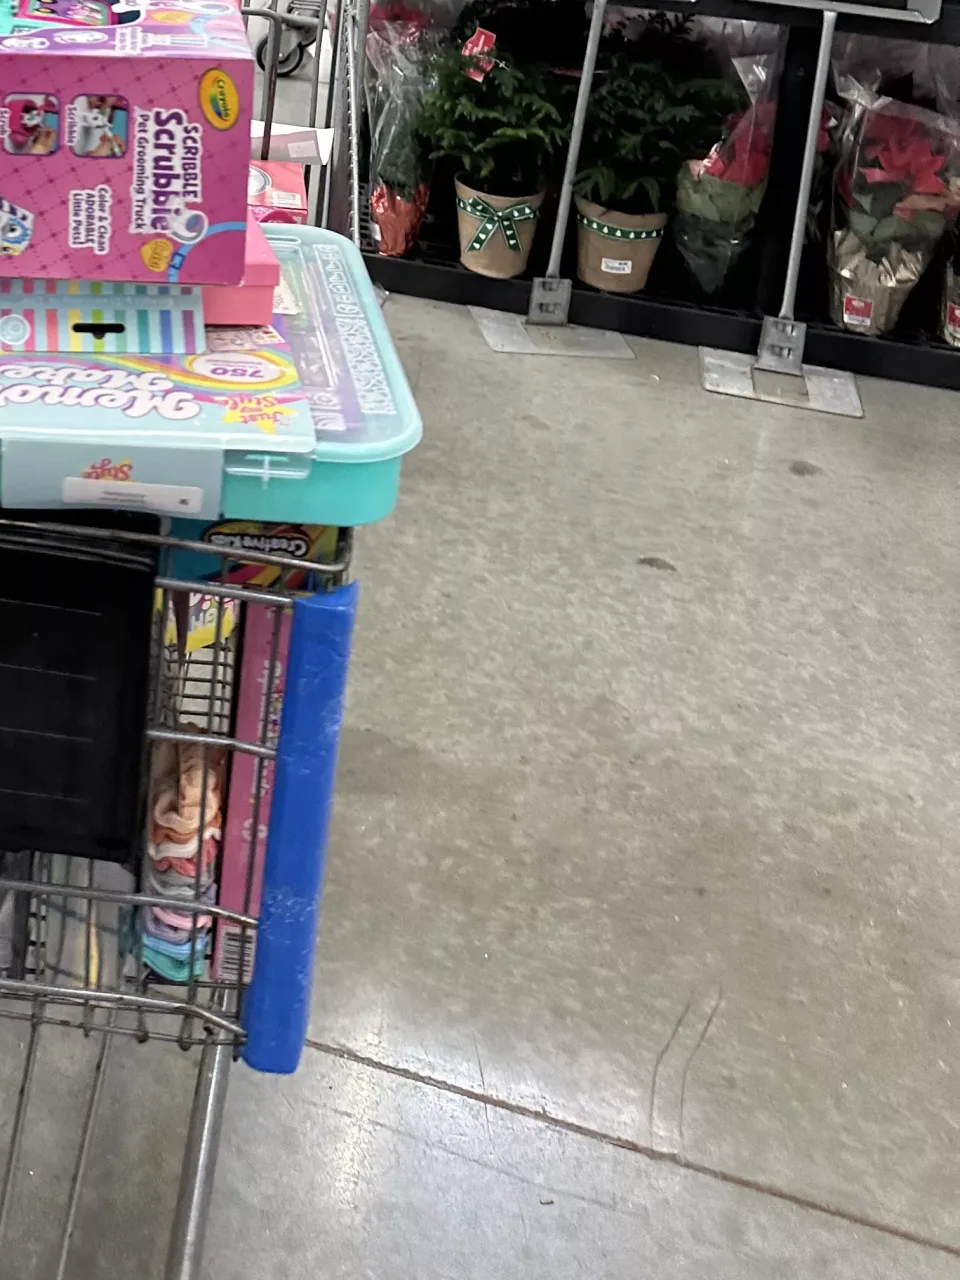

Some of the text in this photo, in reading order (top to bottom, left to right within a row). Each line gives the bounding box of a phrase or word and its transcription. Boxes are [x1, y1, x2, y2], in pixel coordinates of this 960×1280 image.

[216, 79, 231, 119] Crayola
[66, 106, 77, 145] Scribble
[133, 114, 150, 230] Pet Grooming Truck
[151, 111, 184, 230] Scrubbie
[181, 125, 200, 200] SCRIBBLE
[71, 193, 83, 216] Little
[84, 192, 96, 244] ADORABLE
[97, 187, 109, 213] Color
[95, 223, 108, 252] Clean
[210, 365, 266, 379] 750
